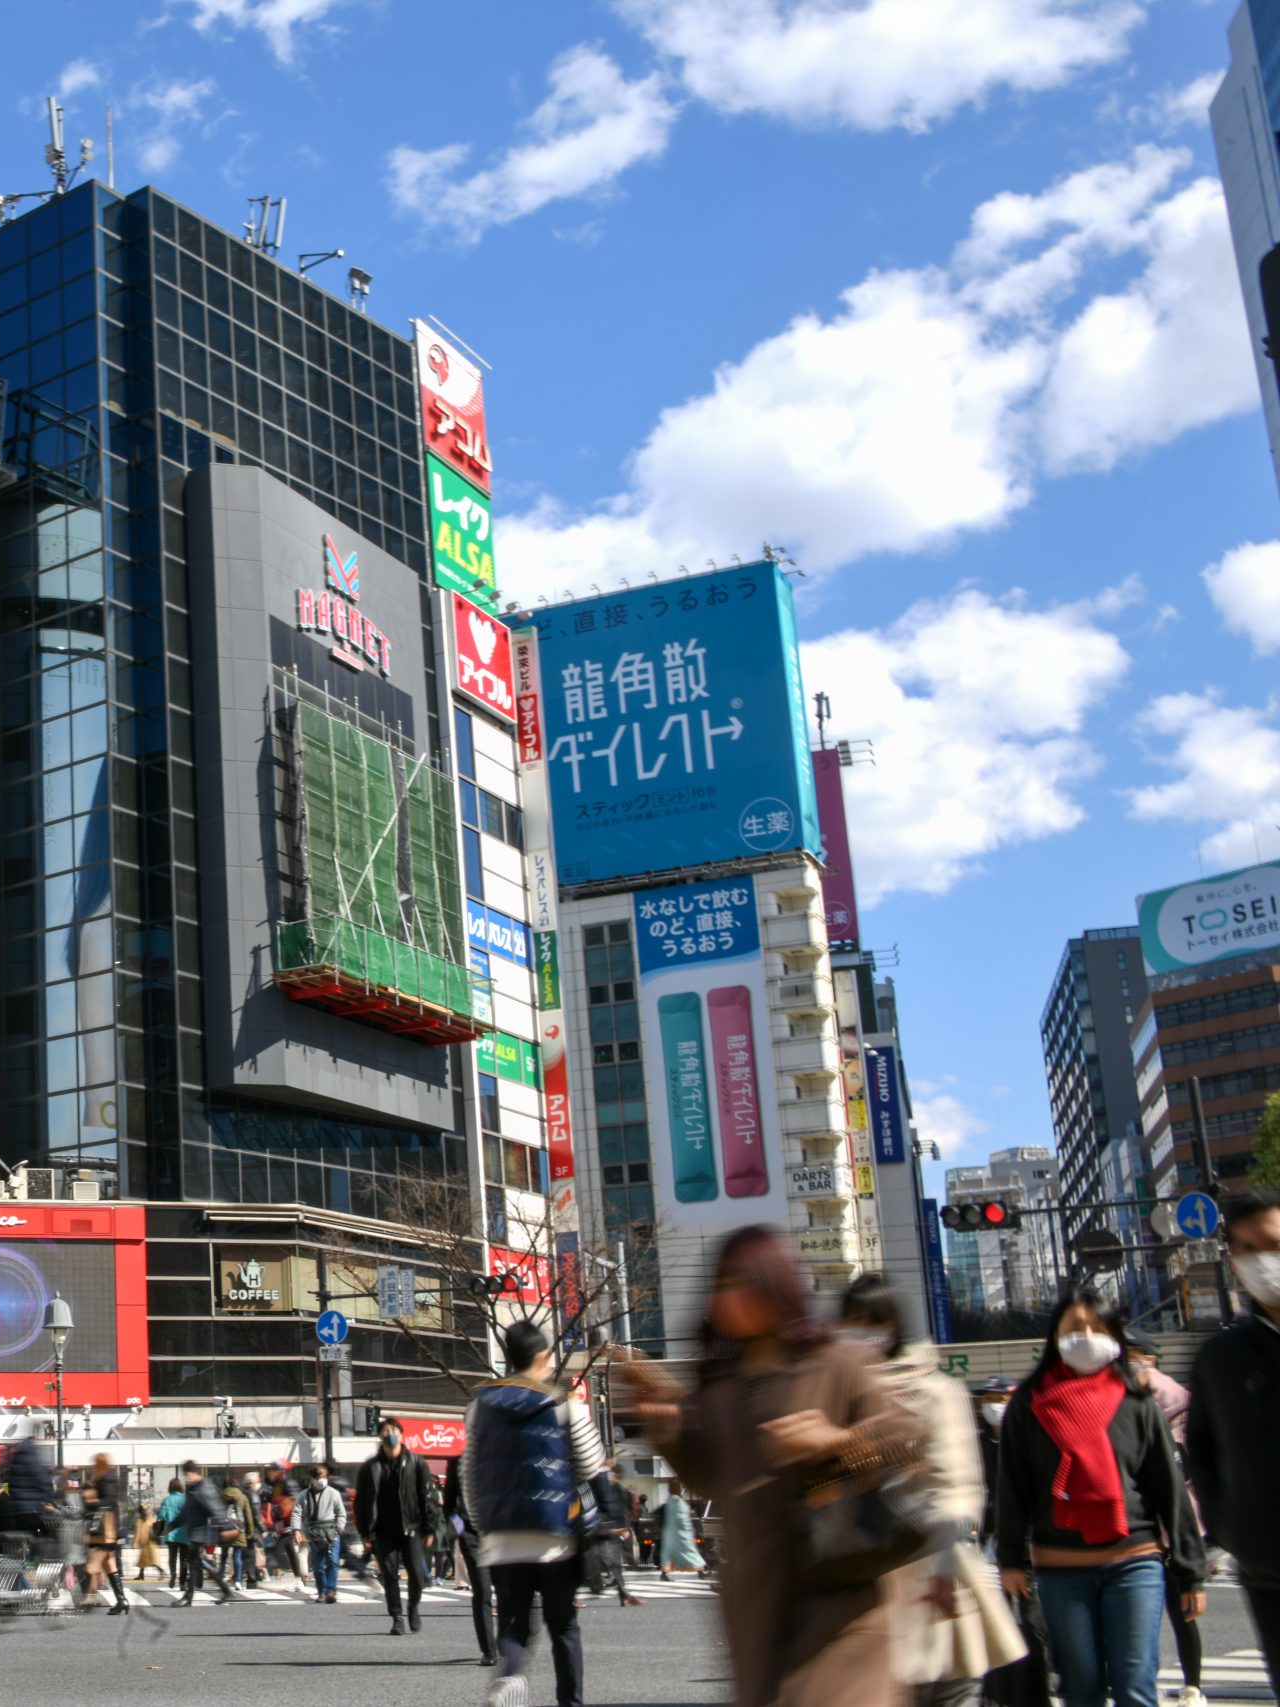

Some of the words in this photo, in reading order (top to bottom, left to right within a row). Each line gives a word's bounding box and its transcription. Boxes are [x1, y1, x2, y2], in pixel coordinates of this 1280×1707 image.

[433, 399, 493, 472] アコム
[432, 472, 490, 541] レイク
[435, 521, 495, 588] ALSA
[295, 587, 392, 678] MAGNET
[459, 653, 512, 710] アイフル
[560, 637, 711, 725] 龍角散
[522, 711, 539, 760] アイフル
[548, 708, 744, 793] ダイレクト
[743, 810, 790, 838] 生薬
[534, 855, 550, 928] レオパレス21
[639, 887, 749, 919] 水なしで飲む
[649, 910, 742, 937] のど、直接、
[1182, 896, 1277, 935] TOSEI
[540, 932, 552, 963] レイク
[661, 931, 734, 957] うるおう
[541, 963, 555, 1004] ALSA
[677, 1040, 706, 1151] 龍角散ダイレクト
[726, 1034, 756, 1145] 龍角散ダイレクト
[875, 1055, 890, 1102] MIZUHO
[549, 1094, 568, 1142] アコム
[554, 1166, 568, 1176] 3F
[792, 1169, 832, 1182] DARTS
[808, 1179, 833, 1191] BAR
[865, 1237, 879, 1249] 3F
[228, 1289, 280, 1300] COFFEE
[249, 1274, 259, 1286] H
[387, 1270, 398, 1315] 渋谷駅前
[938, 1354, 969, 1373] JR
